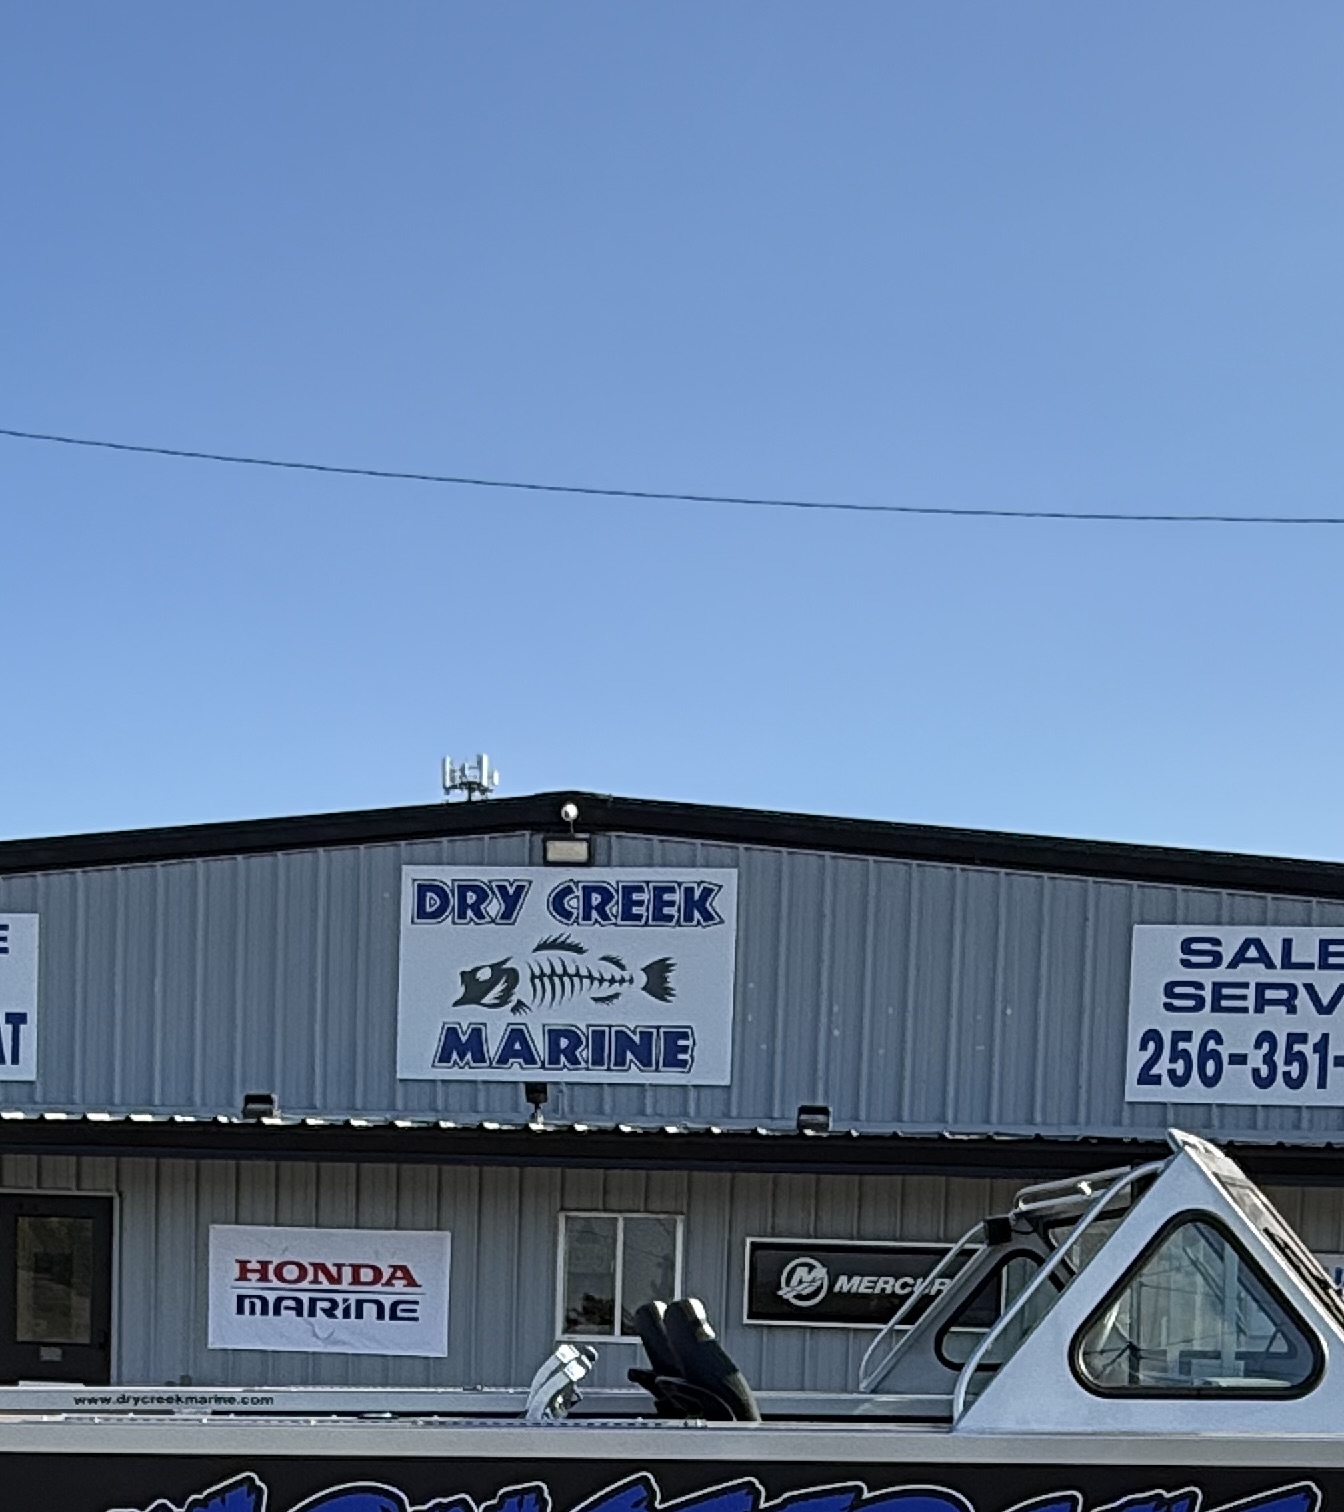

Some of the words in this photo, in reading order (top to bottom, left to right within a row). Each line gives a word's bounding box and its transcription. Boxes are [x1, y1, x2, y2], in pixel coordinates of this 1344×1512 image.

[411, 878, 534, 926] DRY
[546, 879, 726, 928] CREEK
[431, 1021, 696, 1074] MARINE
[233, 1258, 423, 1289] HONDA
[833, 1274, 956, 1296] MERCUR
[235, 1293, 421, 1322] MARINE
[72, 1394, 275, 1408] www.drycreekmarine.com
